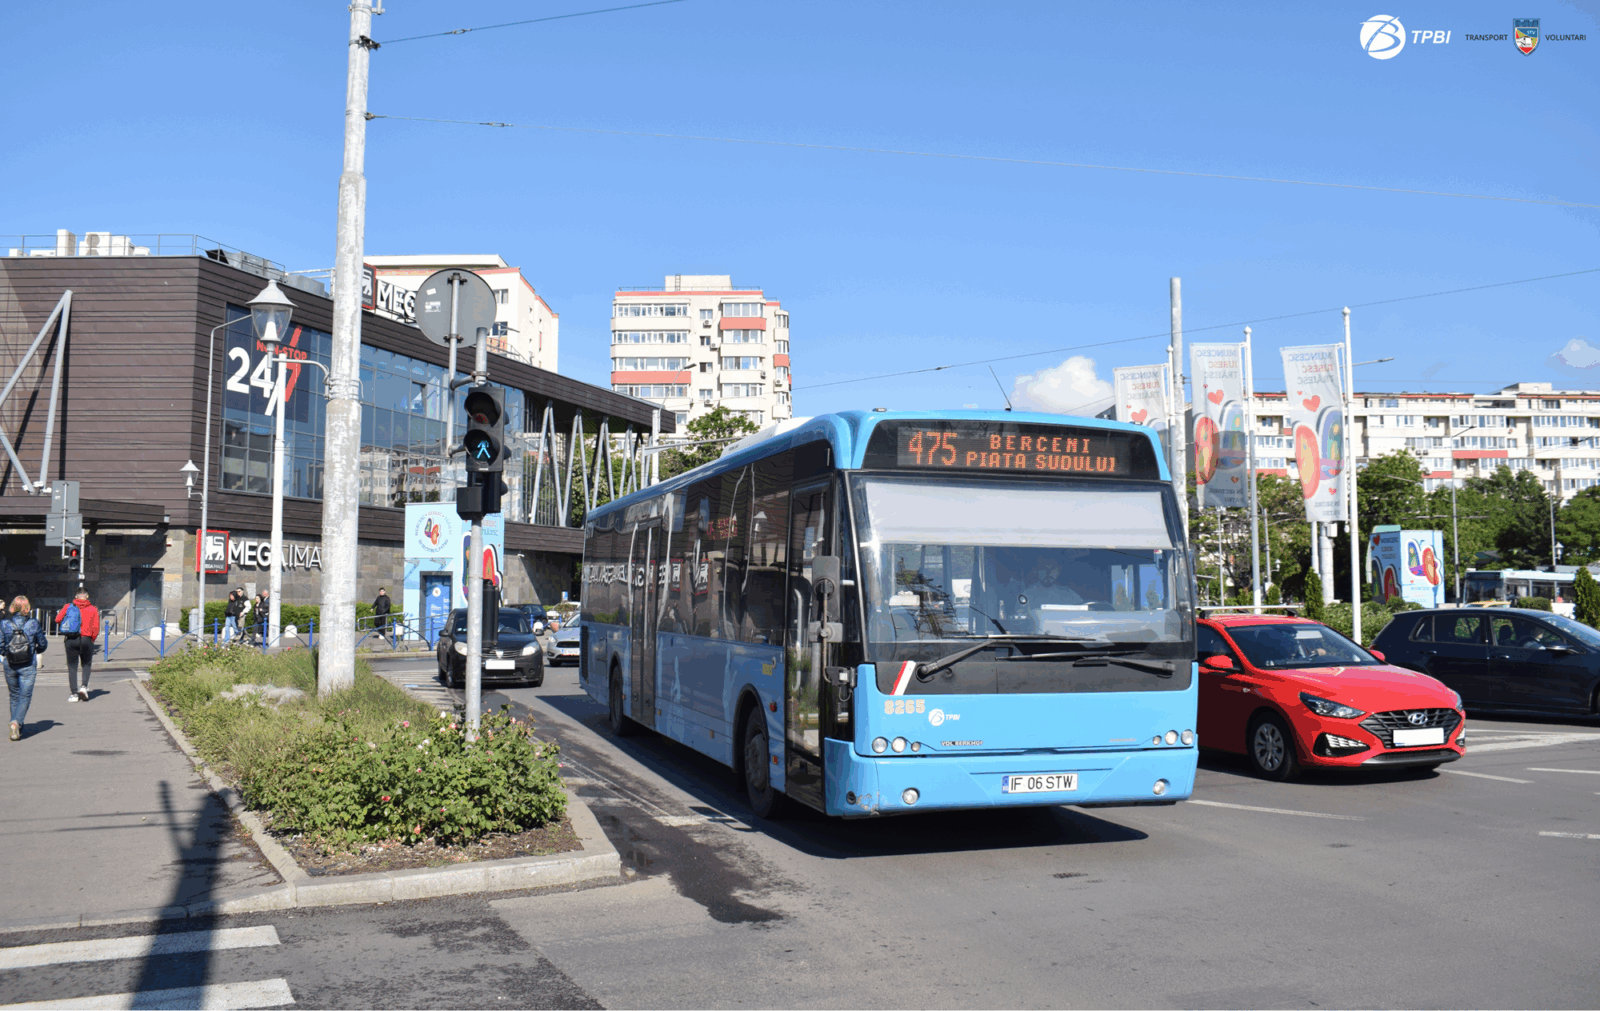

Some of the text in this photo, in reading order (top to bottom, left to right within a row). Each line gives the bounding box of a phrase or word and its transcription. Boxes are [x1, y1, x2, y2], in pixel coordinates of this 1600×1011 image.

[377, 279, 416, 318] MEG
[909, 431, 957, 465] 475
[966, 451, 1115, 472] PIATA SUDULUI
[289, 544, 322, 568] IMA
[884, 699, 925, 714] 8265
[1011, 777, 1023, 790] IF
[1028, 777, 1043, 790] 06
[1046, 775, 1073, 789] STW
